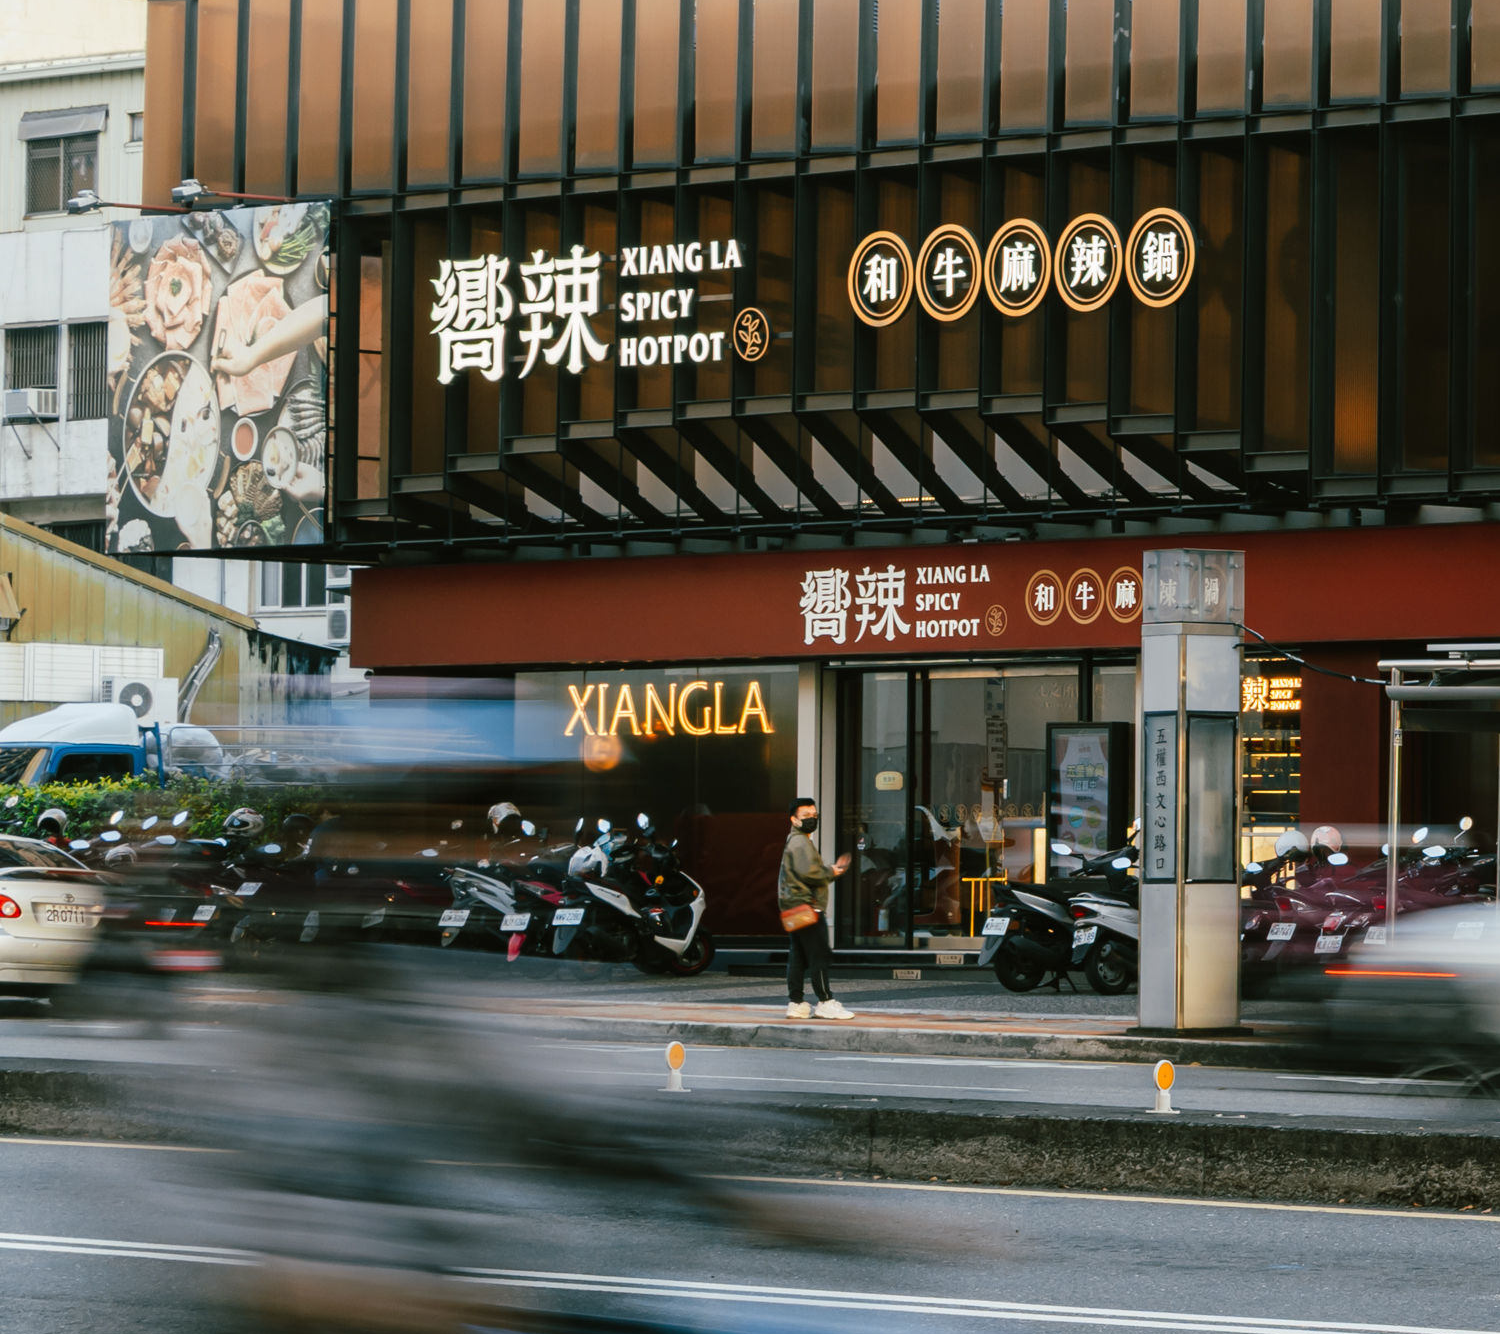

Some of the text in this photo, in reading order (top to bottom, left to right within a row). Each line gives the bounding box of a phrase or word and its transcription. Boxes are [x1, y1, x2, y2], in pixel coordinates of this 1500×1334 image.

[620, 238, 744, 278] XIANG LA
[860, 227, 1182, 305] 和牛麻辣鍋
[430, 244, 610, 385] 嚮辣
[619, 287, 696, 324] SPICY
[619, 329, 727, 368] HOTPOT
[915, 563, 991, 586] XIANG LA
[799, 563, 912, 646] 嚮辣
[915, 592, 962, 612] SPICY
[915, 617, 981, 639] HOTPOT
[563, 679, 776, 738] XIANGLA
[1153, 727, 1168, 871] 五權西文心路口
